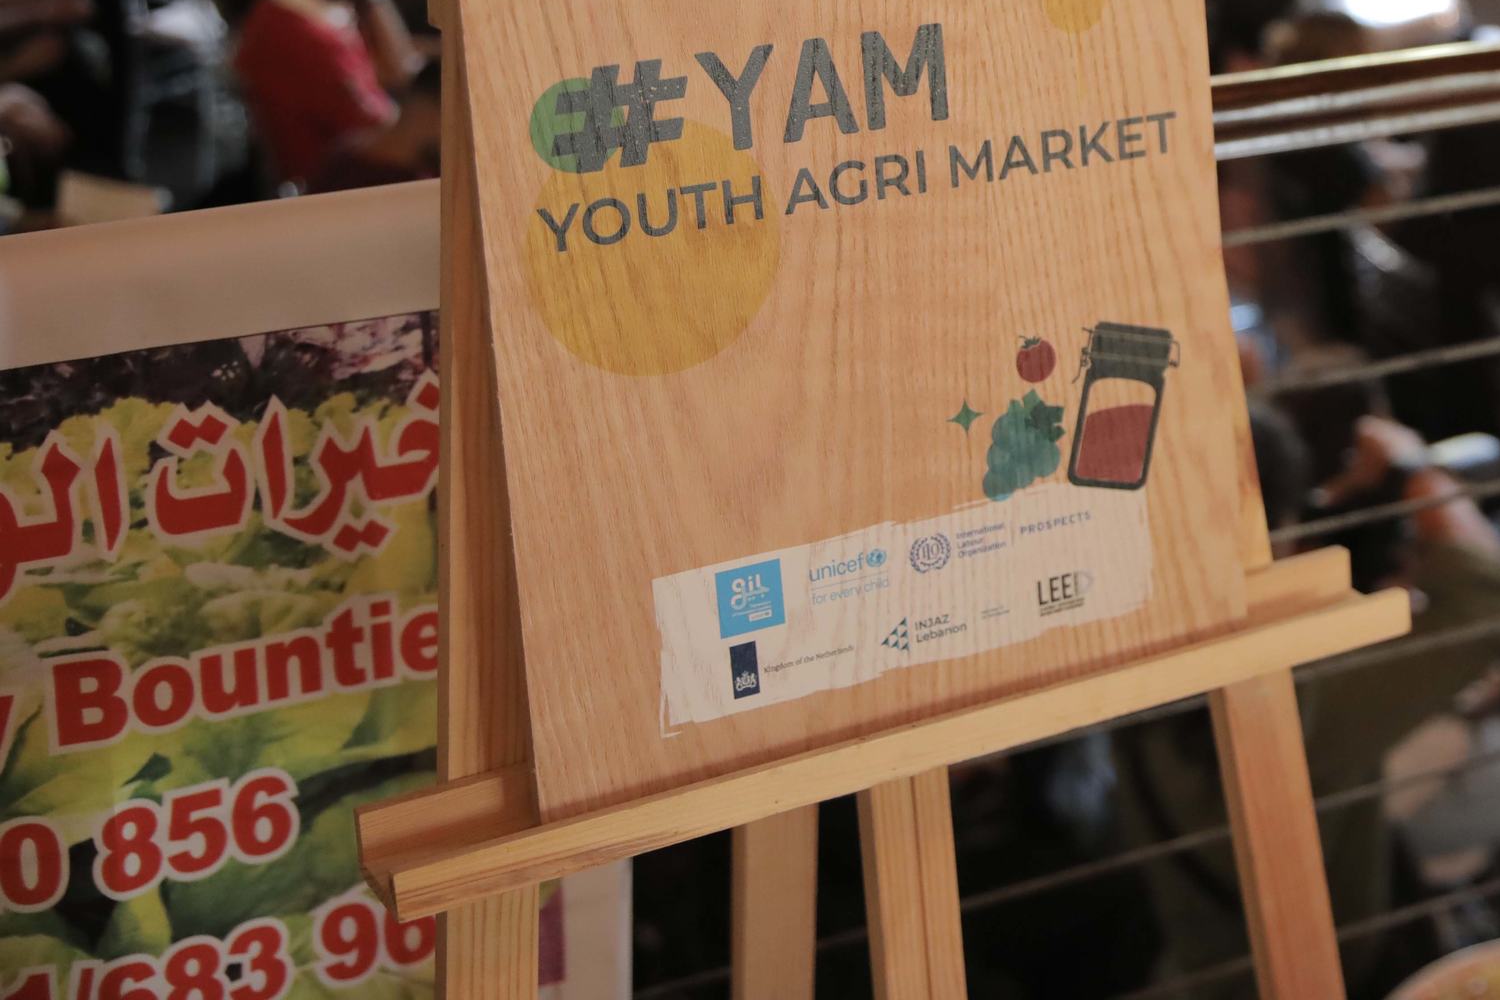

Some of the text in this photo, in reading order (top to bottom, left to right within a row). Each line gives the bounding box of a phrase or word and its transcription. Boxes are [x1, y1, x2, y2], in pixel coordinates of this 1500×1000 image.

[552, 23, 948, 173] #YAM
[536, 112, 1176, 252] YOUTH AGRI MARKET
[809, 552, 864, 581] unicef
[1020, 511, 1090, 534] PROSPECTS
[53, 601, 438, 746] Bountie
[916, 623, 967, 643] Lebanon
[102, 776, 291, 892] 856
